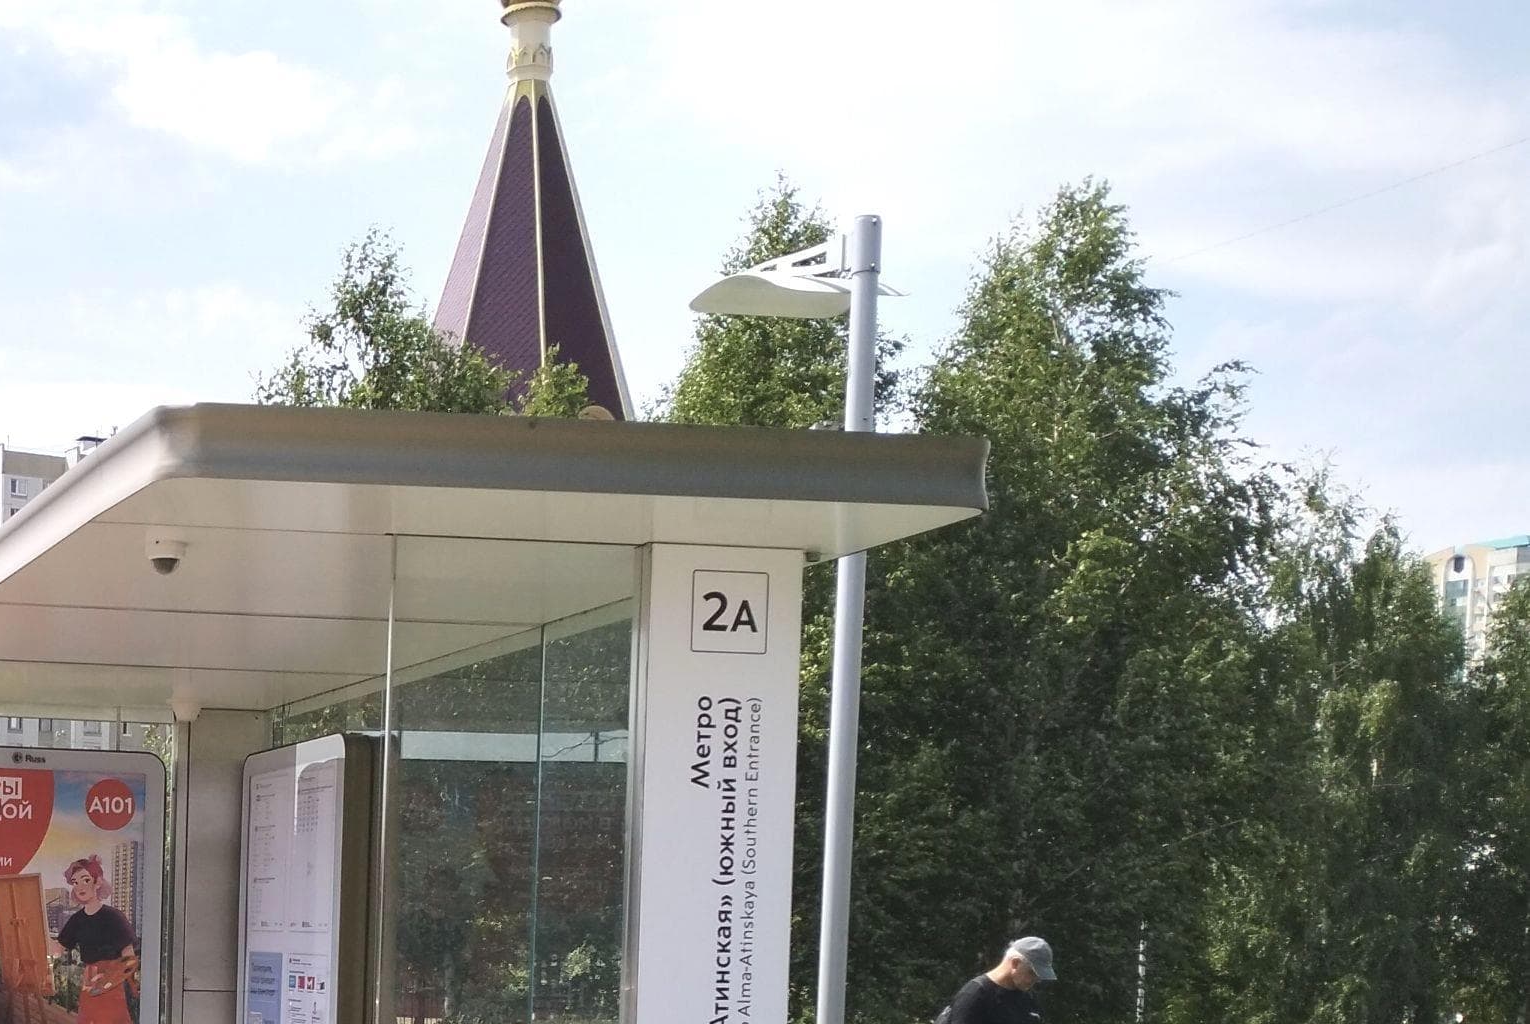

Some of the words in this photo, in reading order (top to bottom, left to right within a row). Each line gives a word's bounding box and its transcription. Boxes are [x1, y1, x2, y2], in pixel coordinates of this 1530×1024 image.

[702, 591, 758, 633] 2А
[25, 754, 46, 764] Russ
[690, 696, 717, 789] Метро
[717, 698, 742, 769] вход)
[745, 697, 763, 782] Entrance)
[88, 796, 133, 815] А101
[711, 777, 737, 886] (южный
[741, 788, 759, 875] (Southern
[739, 880, 758, 1017] Alma-Atinskaya
